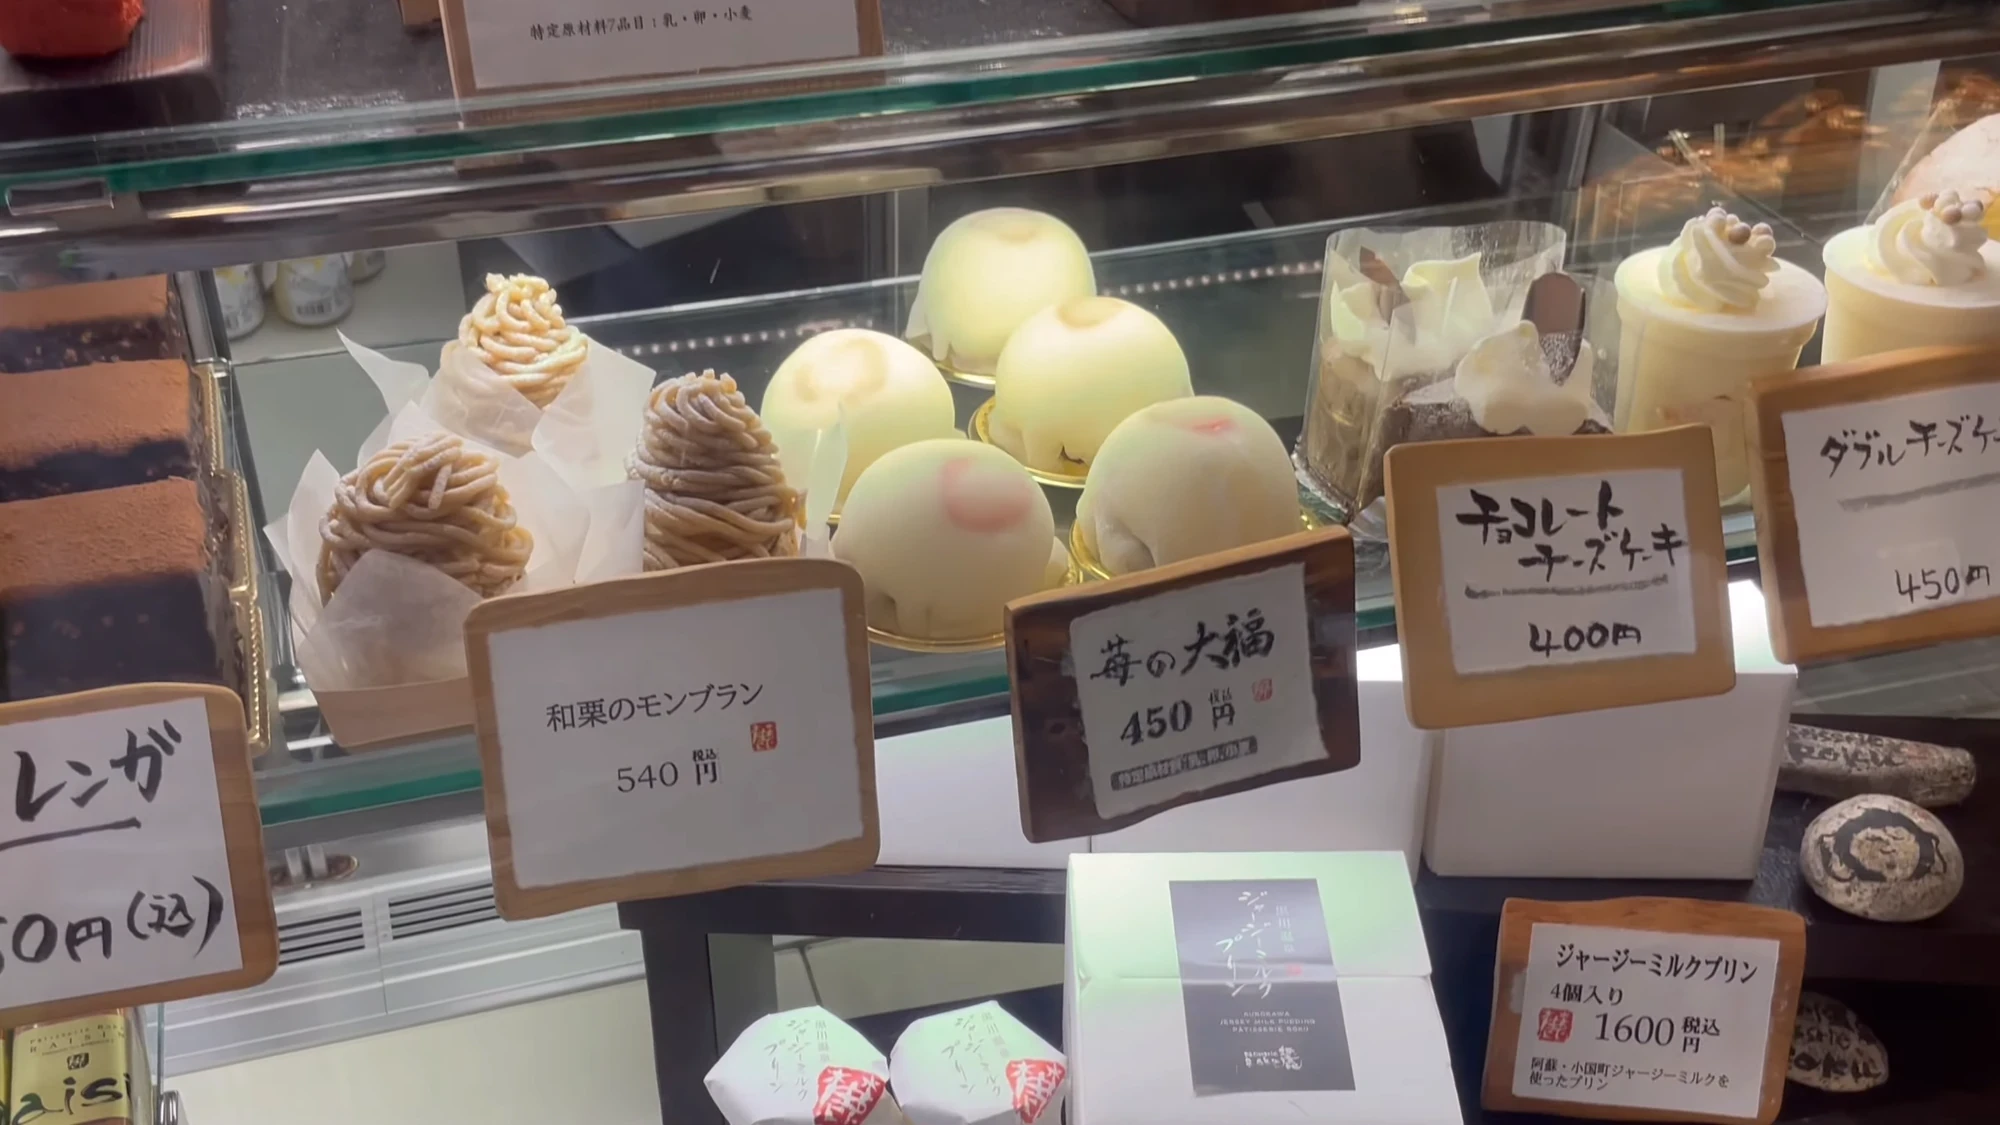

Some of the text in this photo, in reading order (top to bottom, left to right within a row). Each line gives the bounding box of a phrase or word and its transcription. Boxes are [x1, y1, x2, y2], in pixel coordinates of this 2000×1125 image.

[1455, 480, 1624, 545] チョコレート
[1518, 523, 1687, 582] チーズケーキ
[1895, 564, 1990, 603] 450円
[1090, 608, 1275, 687] 苺の大福
[1528, 621, 1641, 657] 400円
[546, 683, 763, 732] 和栗のモンブラン
[1120, 700, 1235, 746] 450 円
[14, 719, 182, 822] レンガ
[617, 761, 718, 792] 540 円
[1556, 943, 1758, 984] ジャージーミルクプリン
[1550, 982, 1623, 1006] 4個入り
[1595, 1012, 1675, 1046] 1600
[1683, 1037, 1700, 1054] 円
[1529, 1071, 1609, 1091] 使ったプリン
